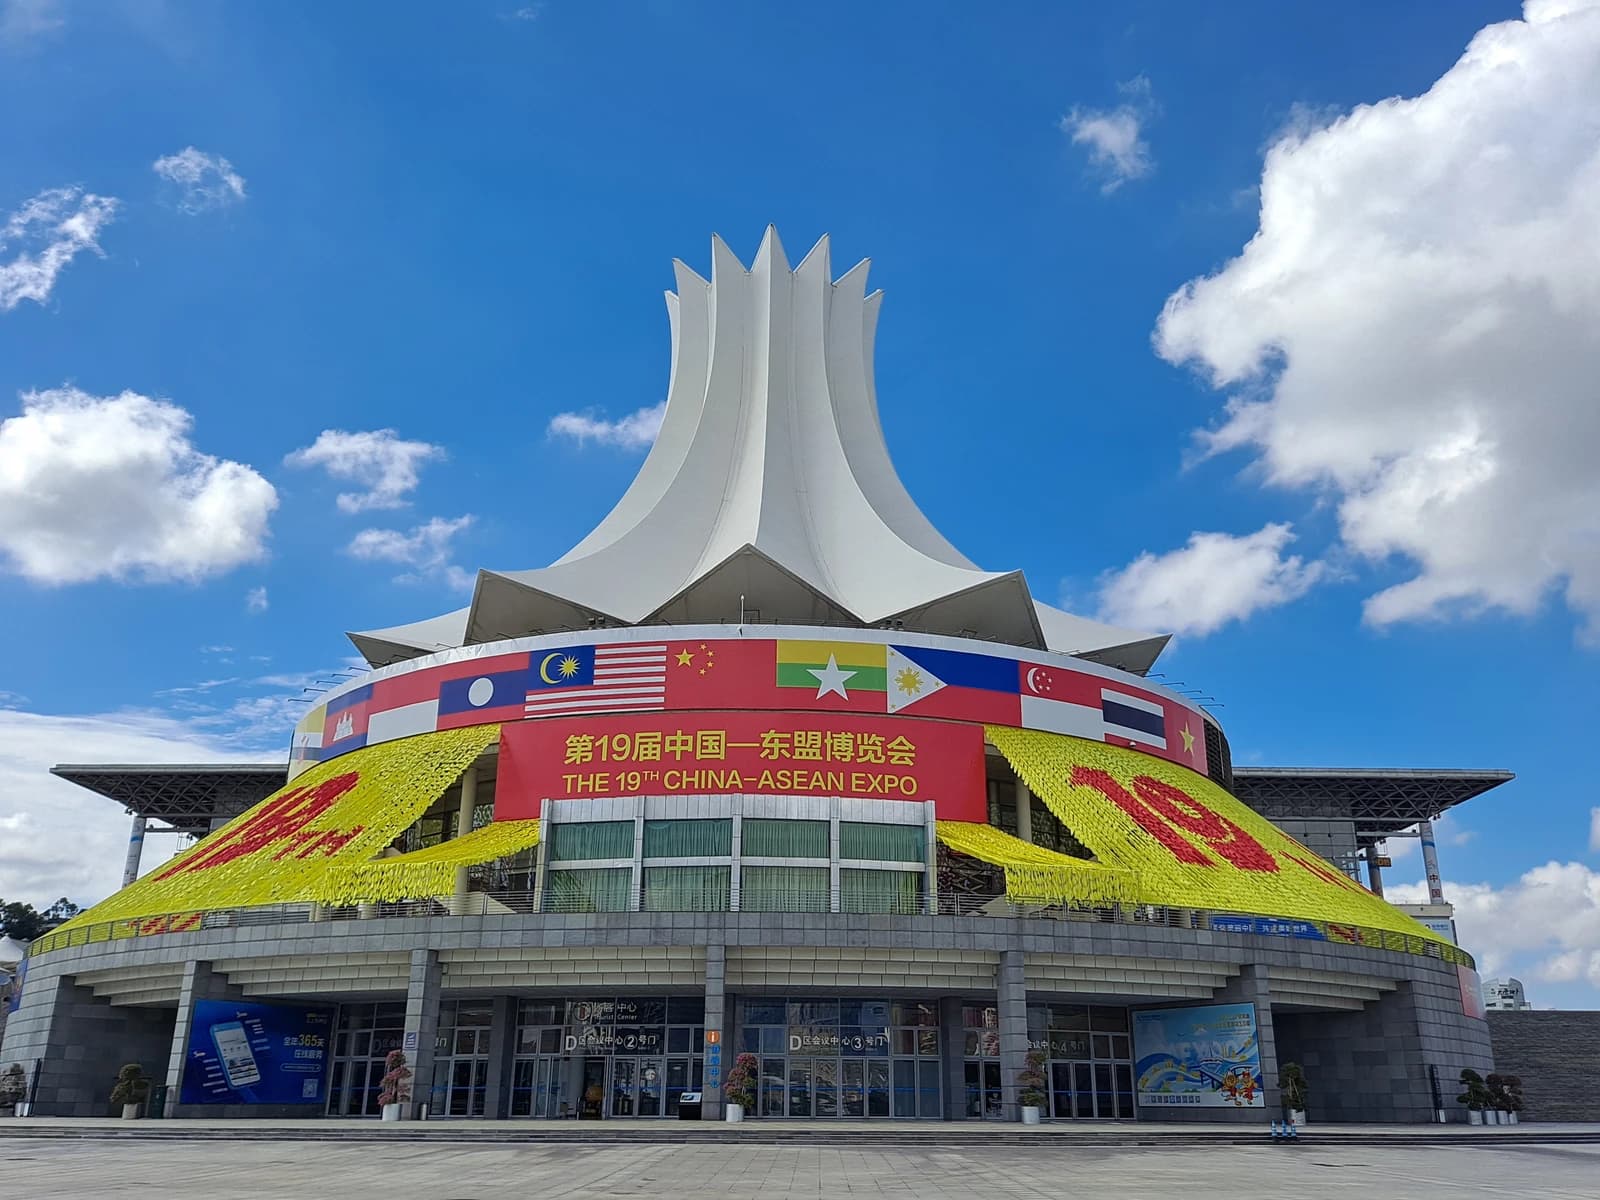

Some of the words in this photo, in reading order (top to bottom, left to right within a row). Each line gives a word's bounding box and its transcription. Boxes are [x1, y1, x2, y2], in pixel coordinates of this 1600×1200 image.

[562, 773, 609, 793] THE
[615, 770, 659, 791] 19TH
[851, 773, 918, 795] EXPO
